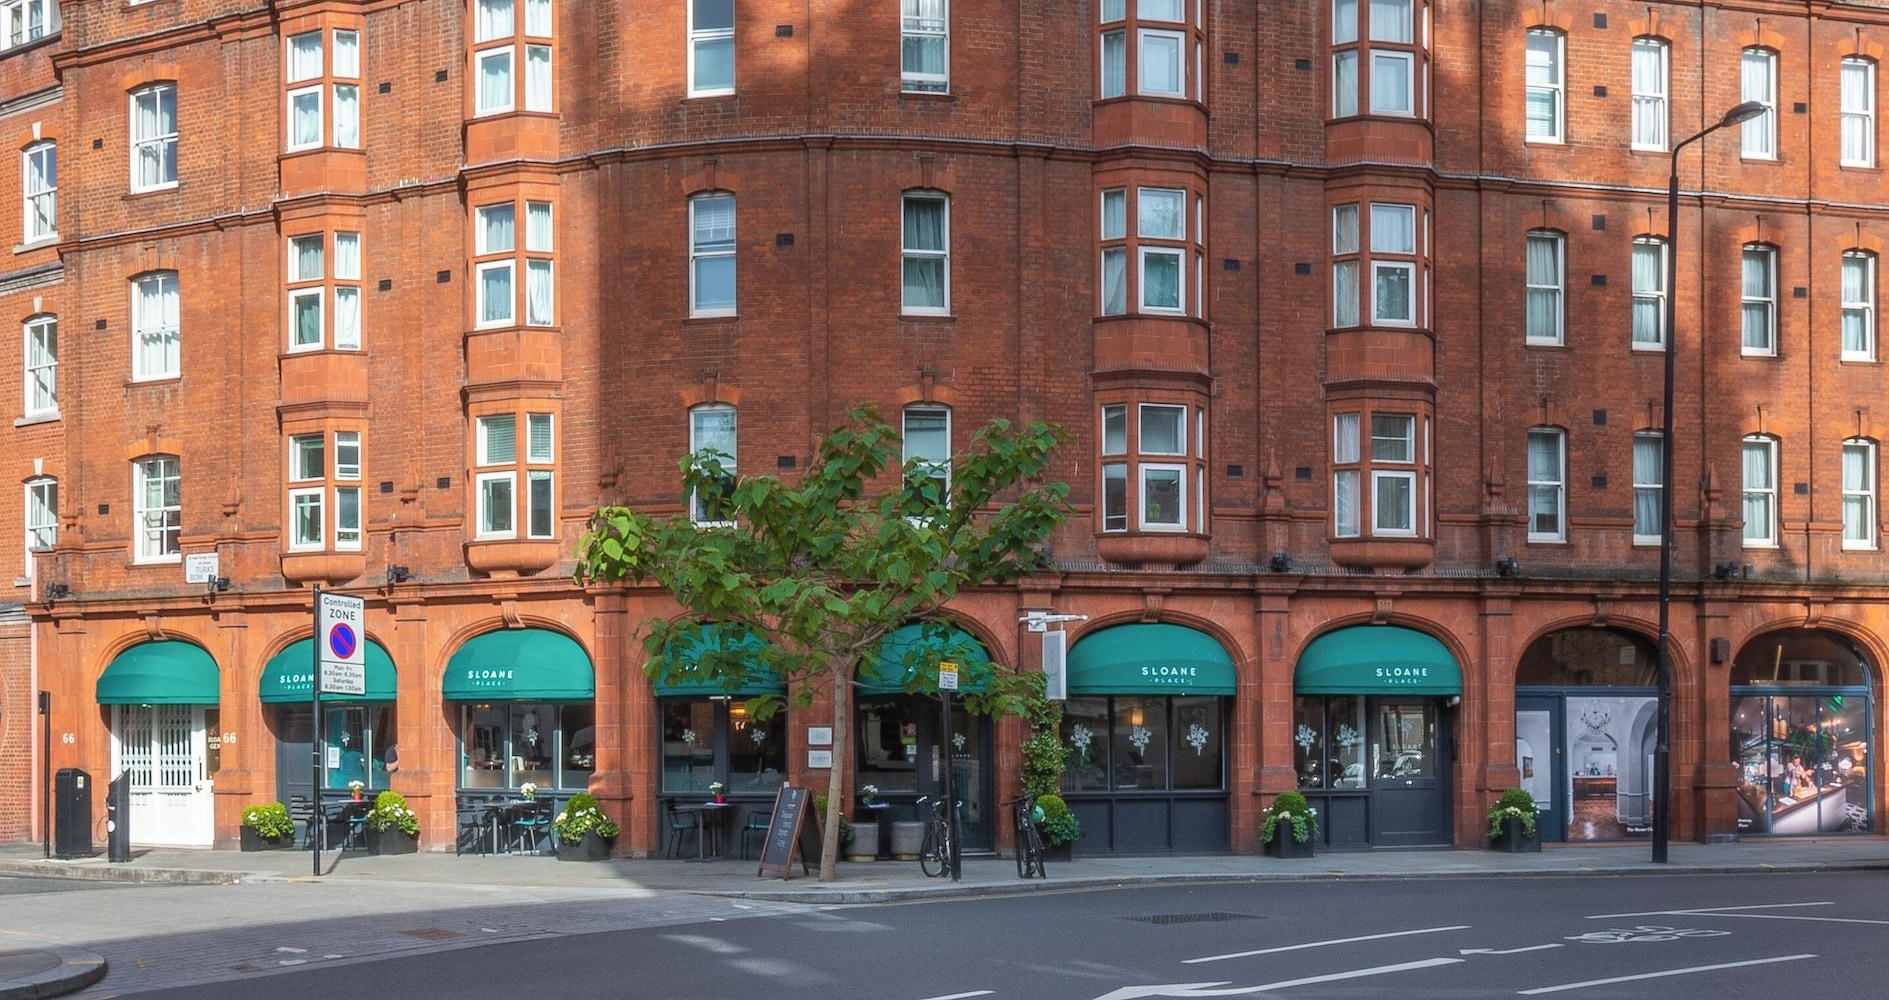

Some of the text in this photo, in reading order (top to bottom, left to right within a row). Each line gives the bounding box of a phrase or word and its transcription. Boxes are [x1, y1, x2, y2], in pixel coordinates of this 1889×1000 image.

[323, 597, 361, 609] Controlled
[329, 608, 356, 621] ZONE
[467, 670, 513, 679] SLOANE
[1141, 666, 1196, 676] SLOANE
[1376, 667, 1428, 677] SLOANE
[280, 674, 314, 684] SLOAN
[333, 677, 354, 685] Saturday
[62, 732, 75, 744] 66
[223, 732, 237, 744] 66
